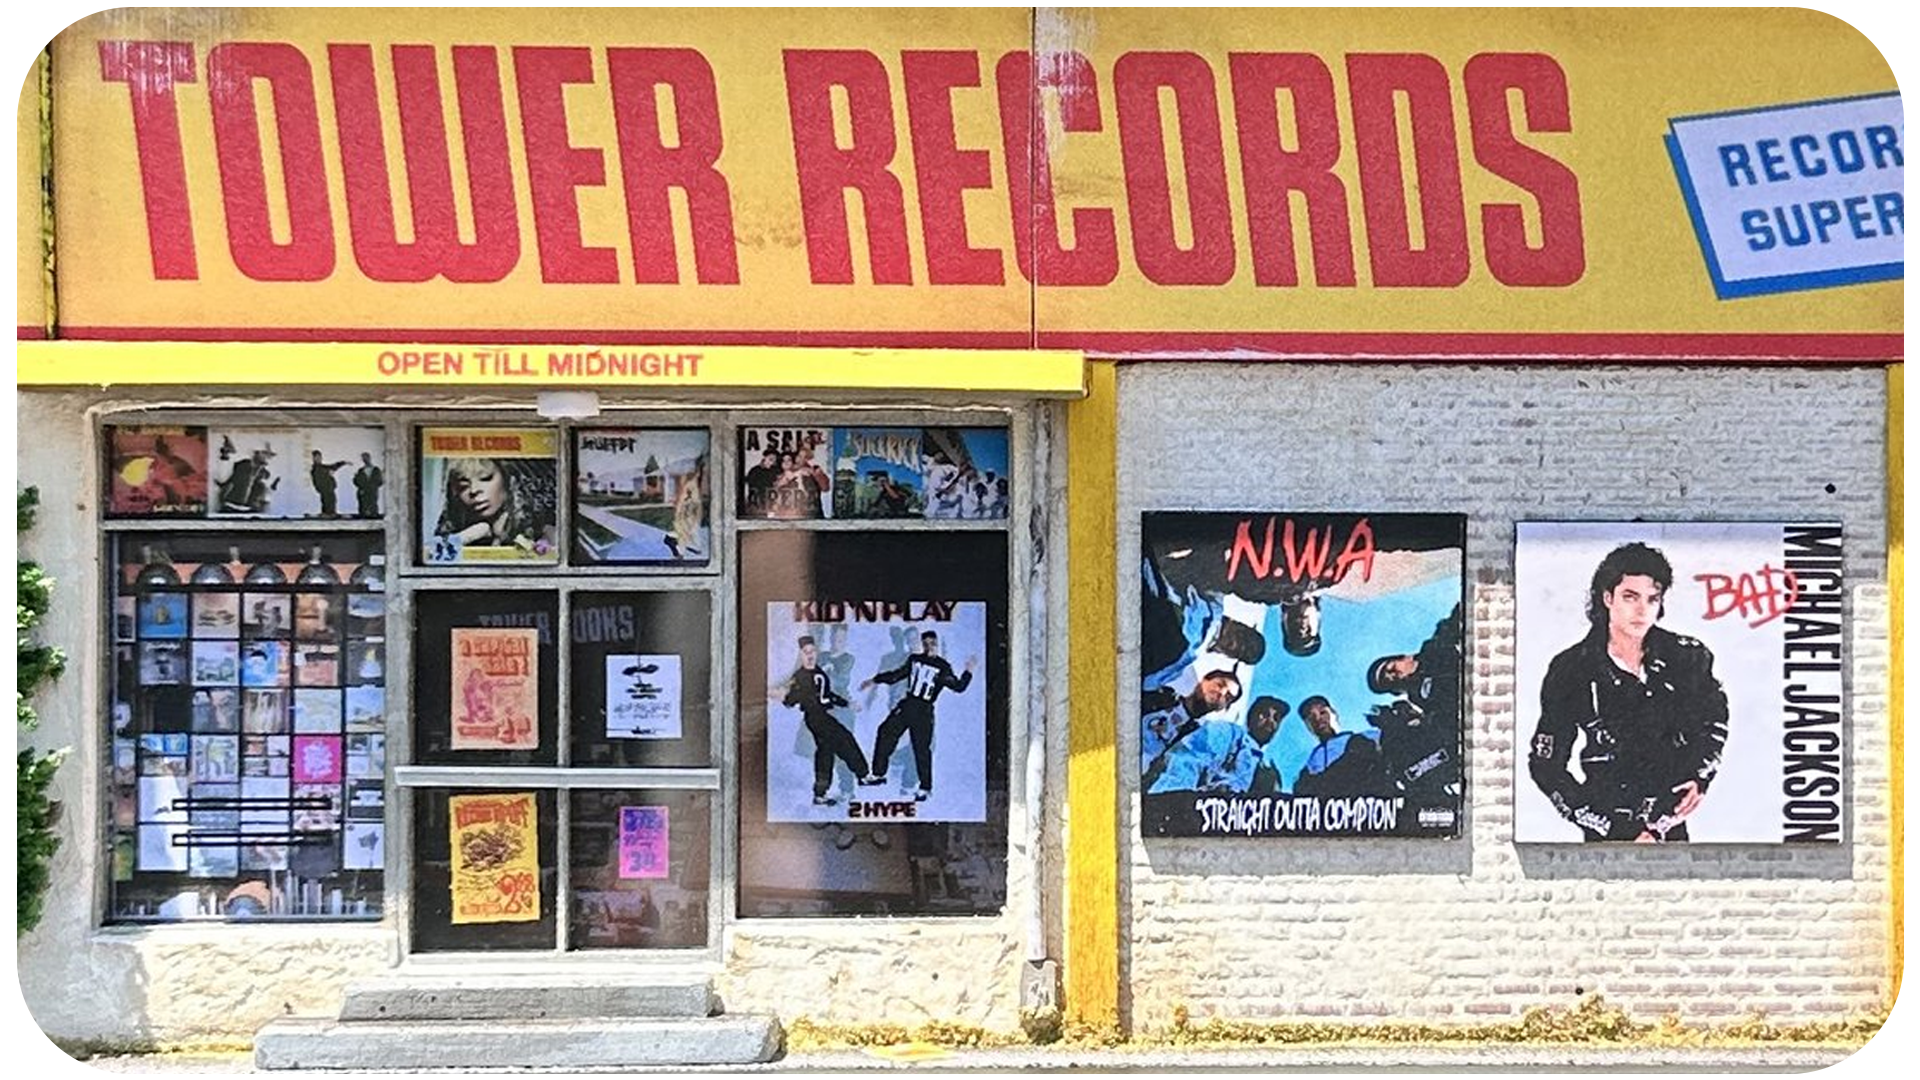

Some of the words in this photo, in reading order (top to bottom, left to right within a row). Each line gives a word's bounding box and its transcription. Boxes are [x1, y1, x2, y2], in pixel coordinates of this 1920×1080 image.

[97, 40, 741, 285] TOWER
[782, 48, 1586, 287] RECORDS
[377, 351, 464, 376] OPEN
[473, 350, 539, 376] TILL
[548, 350, 704, 377] MIDNIGHT
[746, 430, 760, 451] A
[795, 600, 845, 623] KID
[882, 600, 958, 623] PLAY
[1693, 563, 1799, 629] BAD
[1783, 526, 1843, 680] MICHAEL
[1782, 683, 1841, 844] JACKSON
[863, 801, 916, 818] HYPE
[1273, 797, 1320, 831] OUTTA
